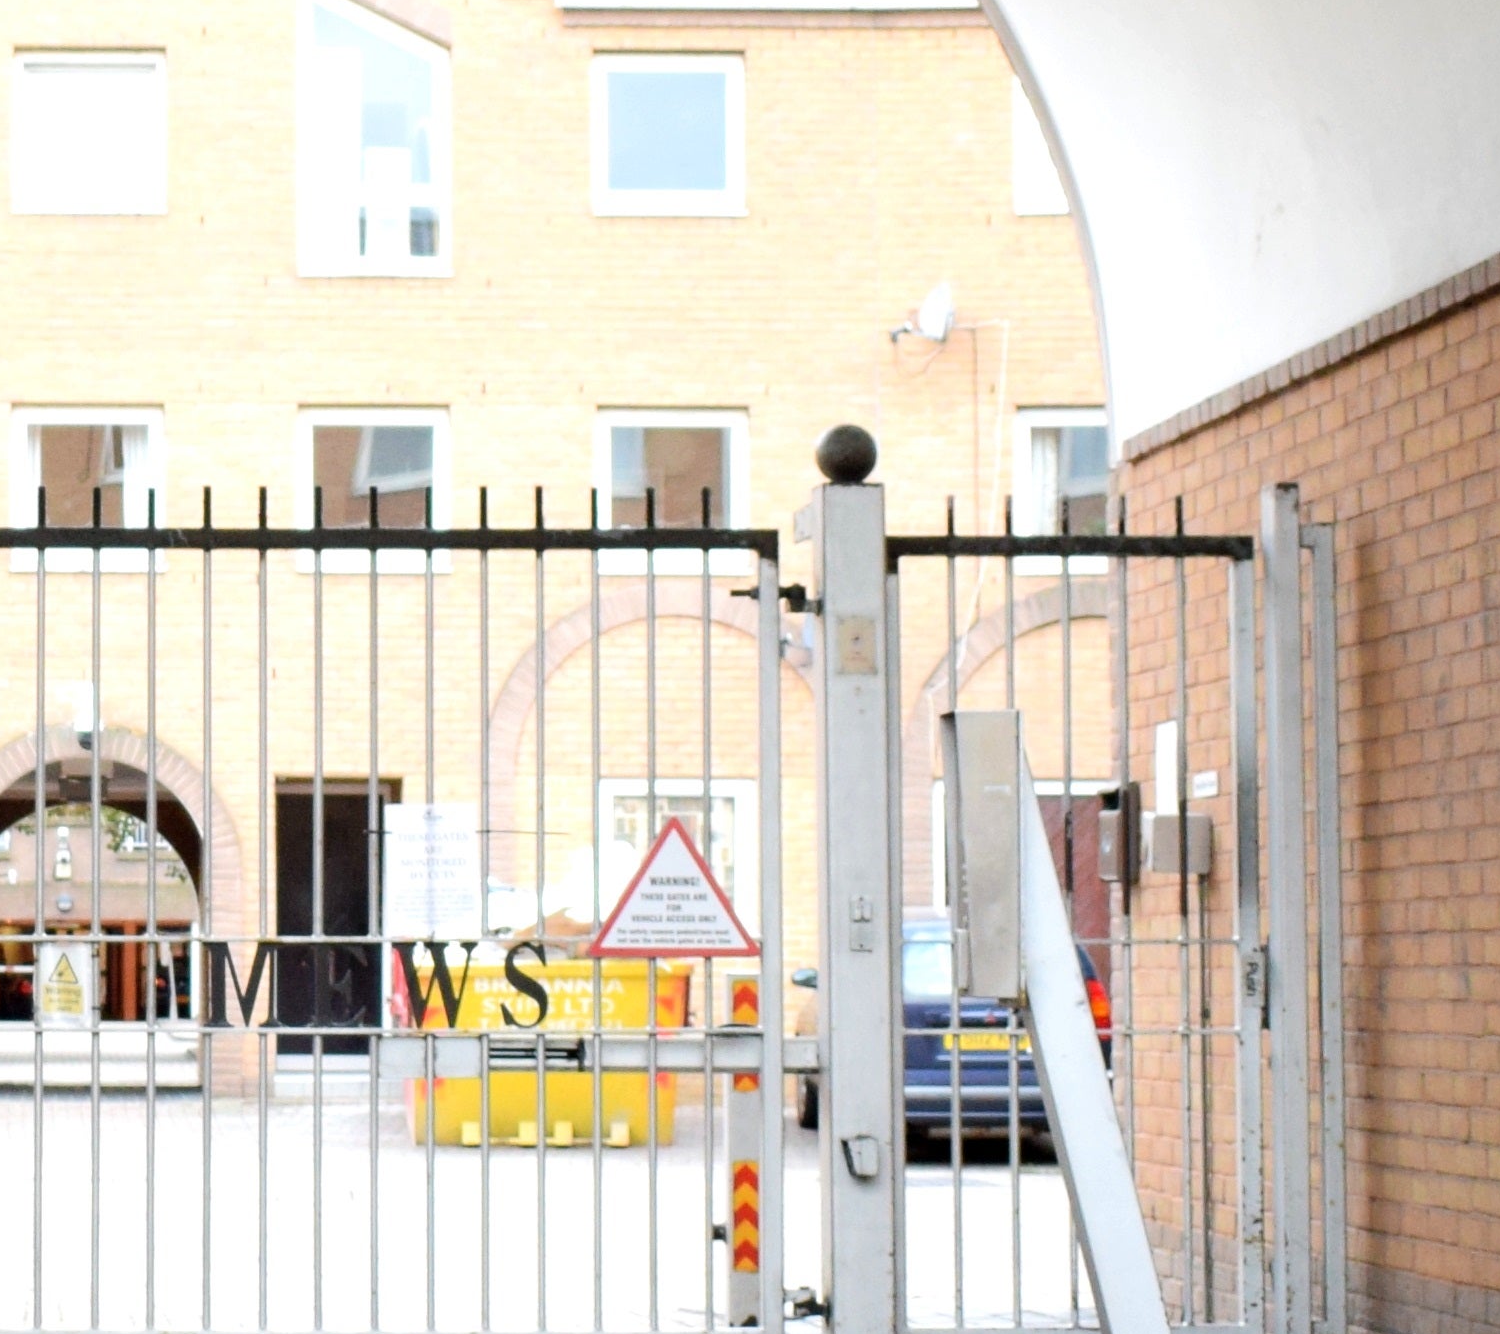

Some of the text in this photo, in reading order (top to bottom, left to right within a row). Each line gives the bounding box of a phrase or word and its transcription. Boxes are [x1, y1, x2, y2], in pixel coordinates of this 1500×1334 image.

[649, 877, 700, 886] WARNING!
[640, 893, 708, 901] THESE GATES ARE
[207, 941, 549, 1029] MEWS
